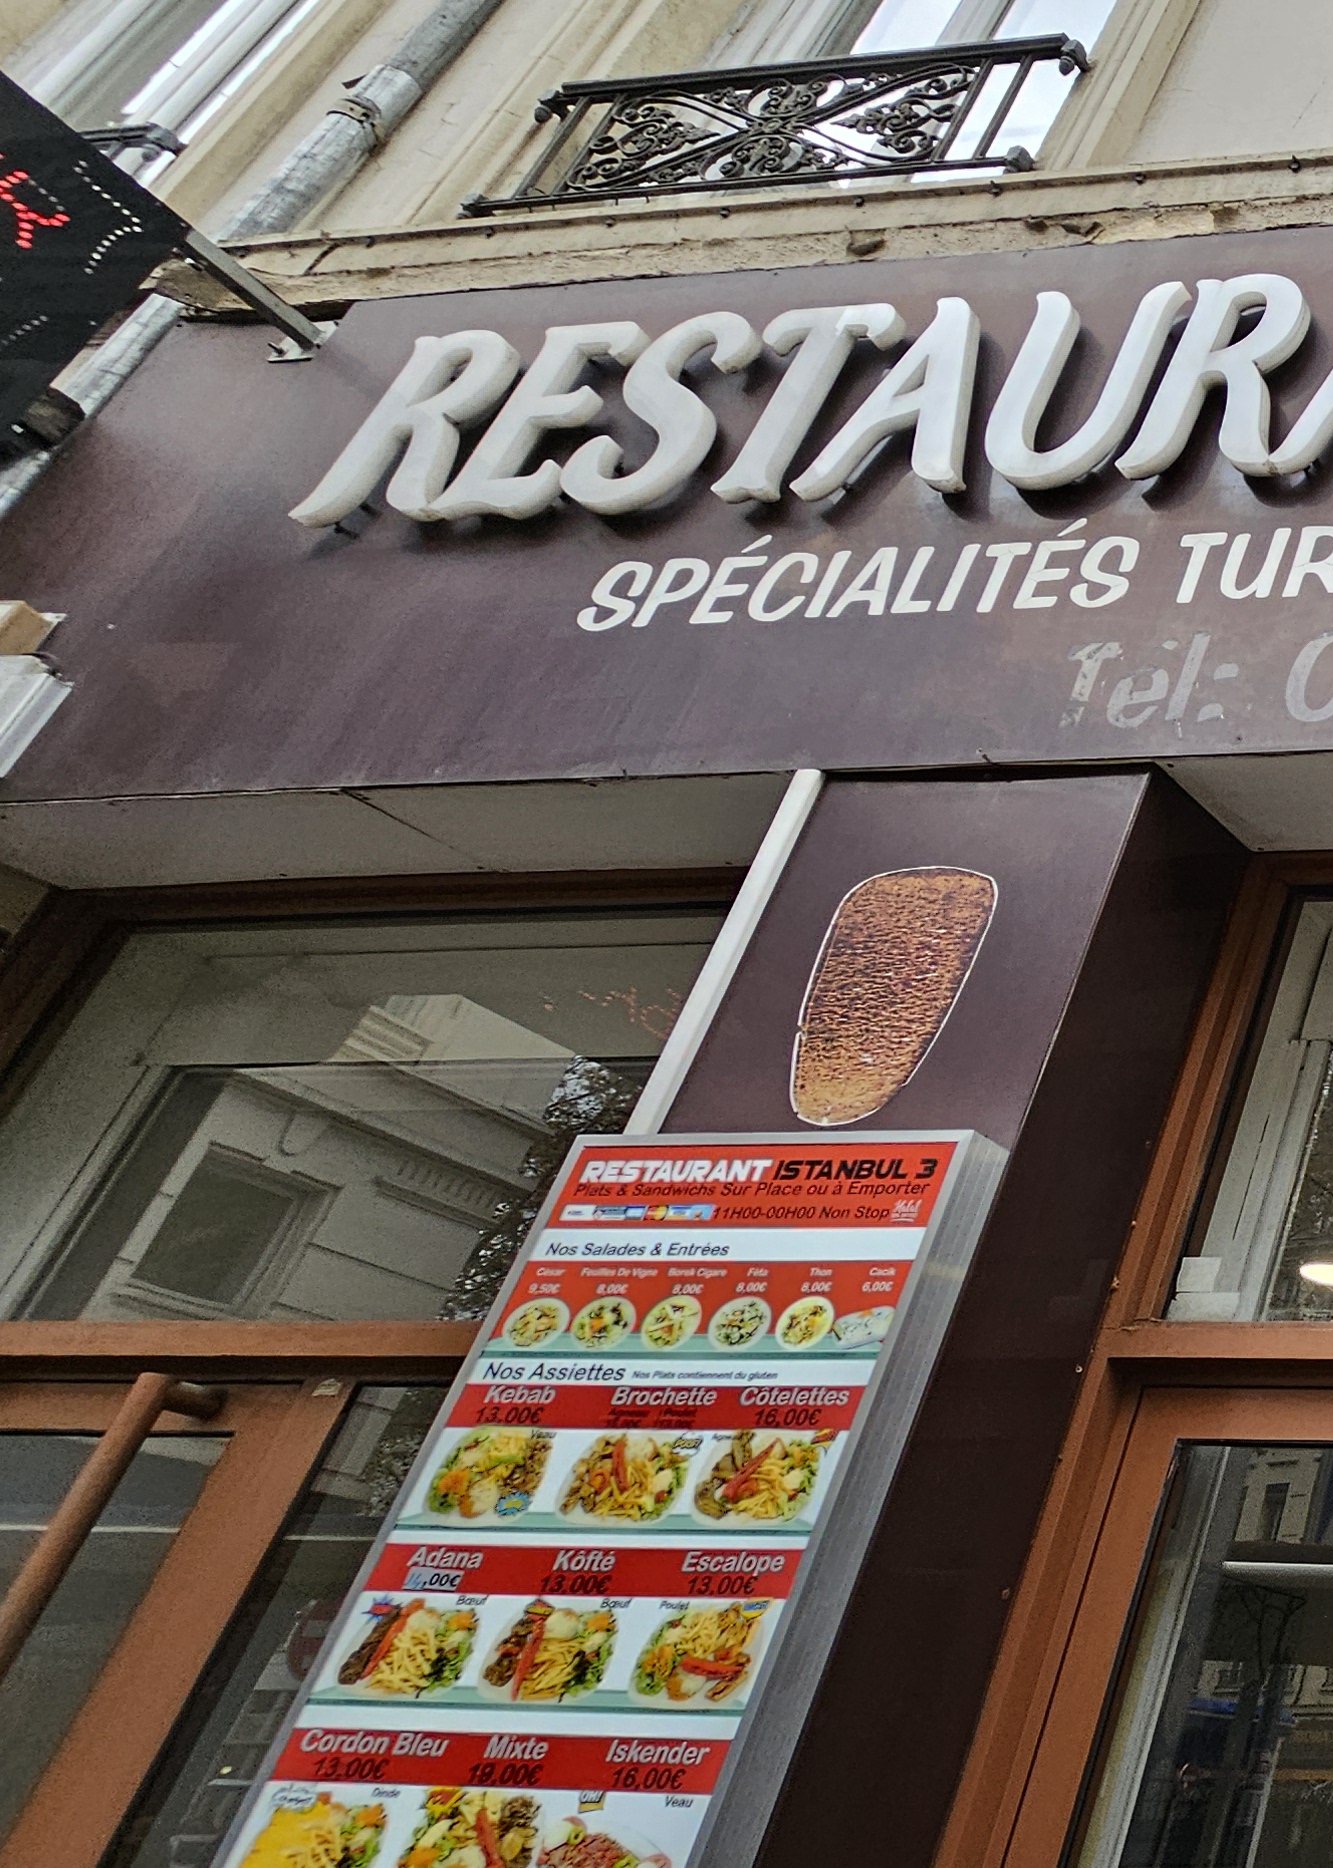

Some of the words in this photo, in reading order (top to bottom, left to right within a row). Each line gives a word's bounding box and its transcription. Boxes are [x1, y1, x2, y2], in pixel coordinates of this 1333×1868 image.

[577, 518, 1139, 631] SPÉCIALITÉS
[579, 1159, 774, 1183] RESTAURANT
[773, 1159, 909, 1181] ISTANBUL
[915, 1158, 939, 1180] 3
[574, 1183, 611, 1196] Plats
[617, 1184, 627, 1196] &
[632, 1183, 715, 1196] Sandwichs
[720, 1183, 751, 1197] Sur
[755, 1182, 802, 1195] Place
[807, 1185, 828, 1195] ou
[832, 1181, 842, 1195] à
[847, 1181, 930, 1198] Emporter
[713, 1206, 815, 1219] 11H00-00H00
[819, 1206, 850, 1219] Non
[854, 1206, 891, 1220] Stop
[545, 1243, 578, 1257] Nos
[582, 1243, 647, 1257] Salades
[650, 1243, 662, 1256] &
[666, 1242, 731, 1256] Entrées
[483, 1362, 525, 1380] Nos
[528, 1363, 627, 1381] Assiettes
[632, 1371, 651, 1379] Nos
[677, 1371, 733, 1379] contiennent
[734, 1371, 747, 1379] du
[748, 1371, 778, 1381] gluten
[483, 1384, 556, 1404] Kebab
[611, 1385, 718, 1406] Brochette
[738, 1385, 850, 1406] Côtelettes
[407, 1546, 484, 1569] Adana
[682, 1551, 785, 1576] Escalope
[301, 1729, 391, 1754] Cordon
[391, 1734, 450, 1757] Bleu
[483, 1734, 549, 1760] Mixte
[605, 1739, 711, 1765] Iskender
[664, 1795, 693, 1808] Veau
